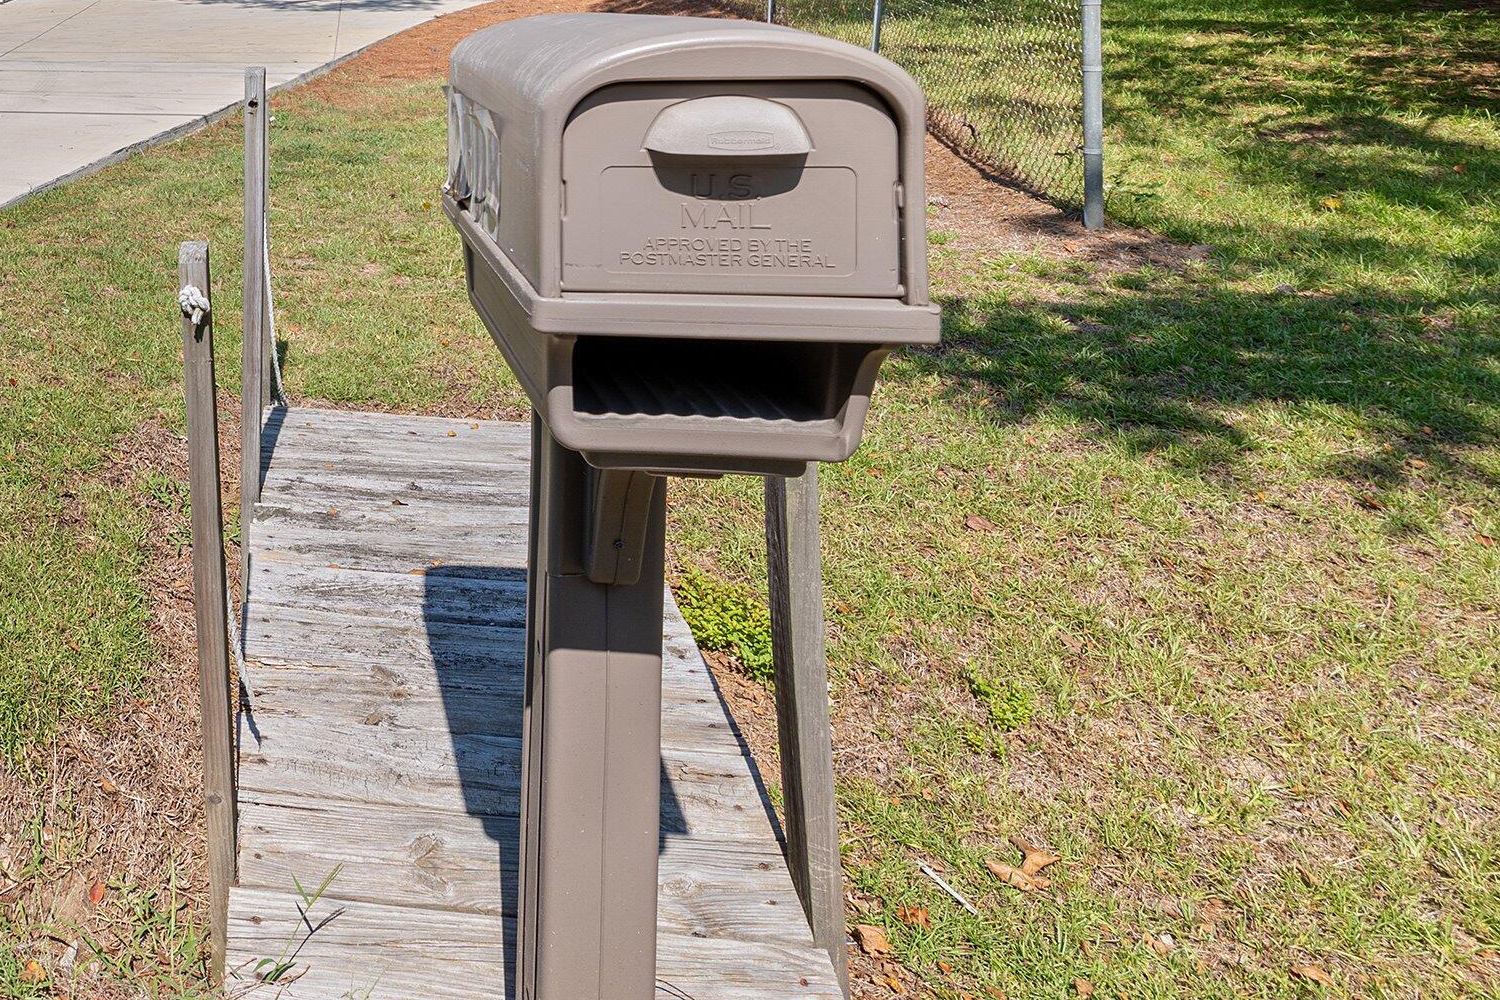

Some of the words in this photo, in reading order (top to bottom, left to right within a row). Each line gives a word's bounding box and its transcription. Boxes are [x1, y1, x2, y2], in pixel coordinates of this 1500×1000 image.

[681, 203, 771, 229] MAIL
[643, 237, 741, 251] APPROVED
[749, 238, 772, 252] BY
[774, 239, 812, 252] THE
[619, 252, 741, 267] POSTMASTER
[747, 254, 836, 269] GENERAL
